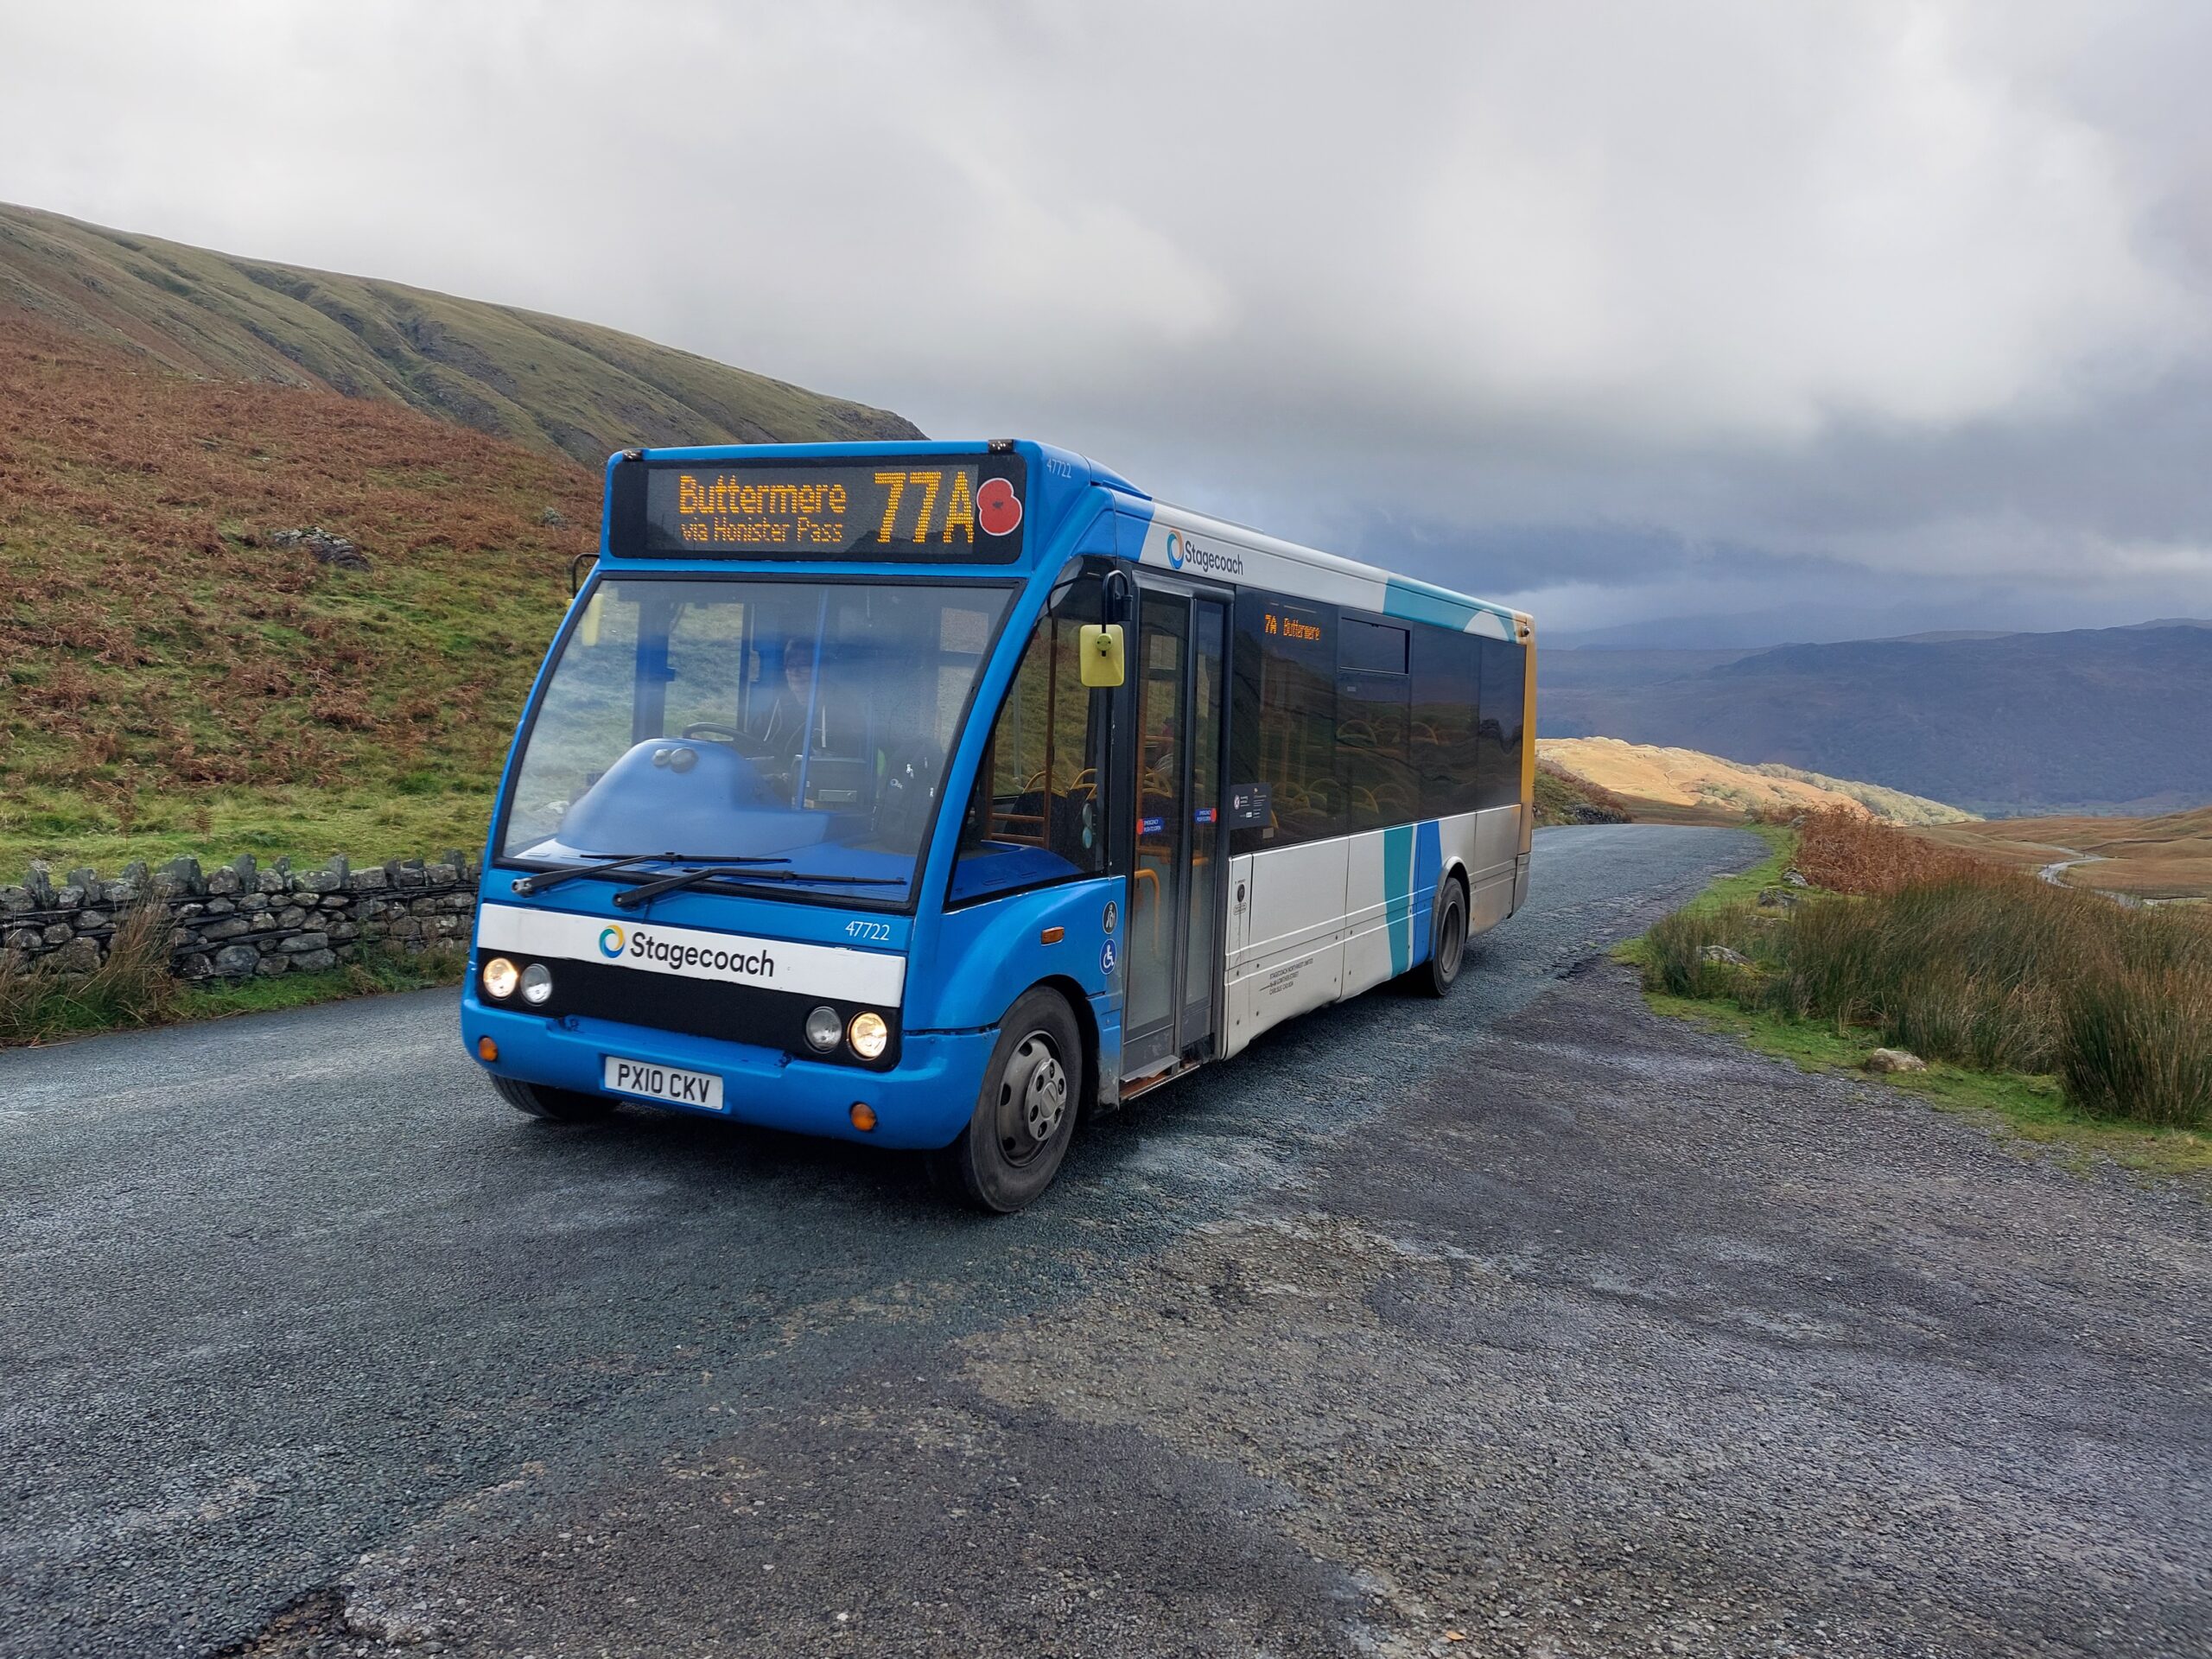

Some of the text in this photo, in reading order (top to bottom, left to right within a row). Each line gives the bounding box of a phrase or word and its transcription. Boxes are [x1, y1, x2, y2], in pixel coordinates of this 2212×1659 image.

[1046, 458, 1071, 479] 47722
[679, 475, 846, 513] Buttermere
[874, 471, 975, 543] 77A
[681, 517, 843, 543] via Honister Pass
[1185, 540, 1243, 575] Stagecoach
[845, 919, 890, 941] 47722
[629, 932, 774, 977] Stagecoach
[669, 1073, 710, 1103] CKV
